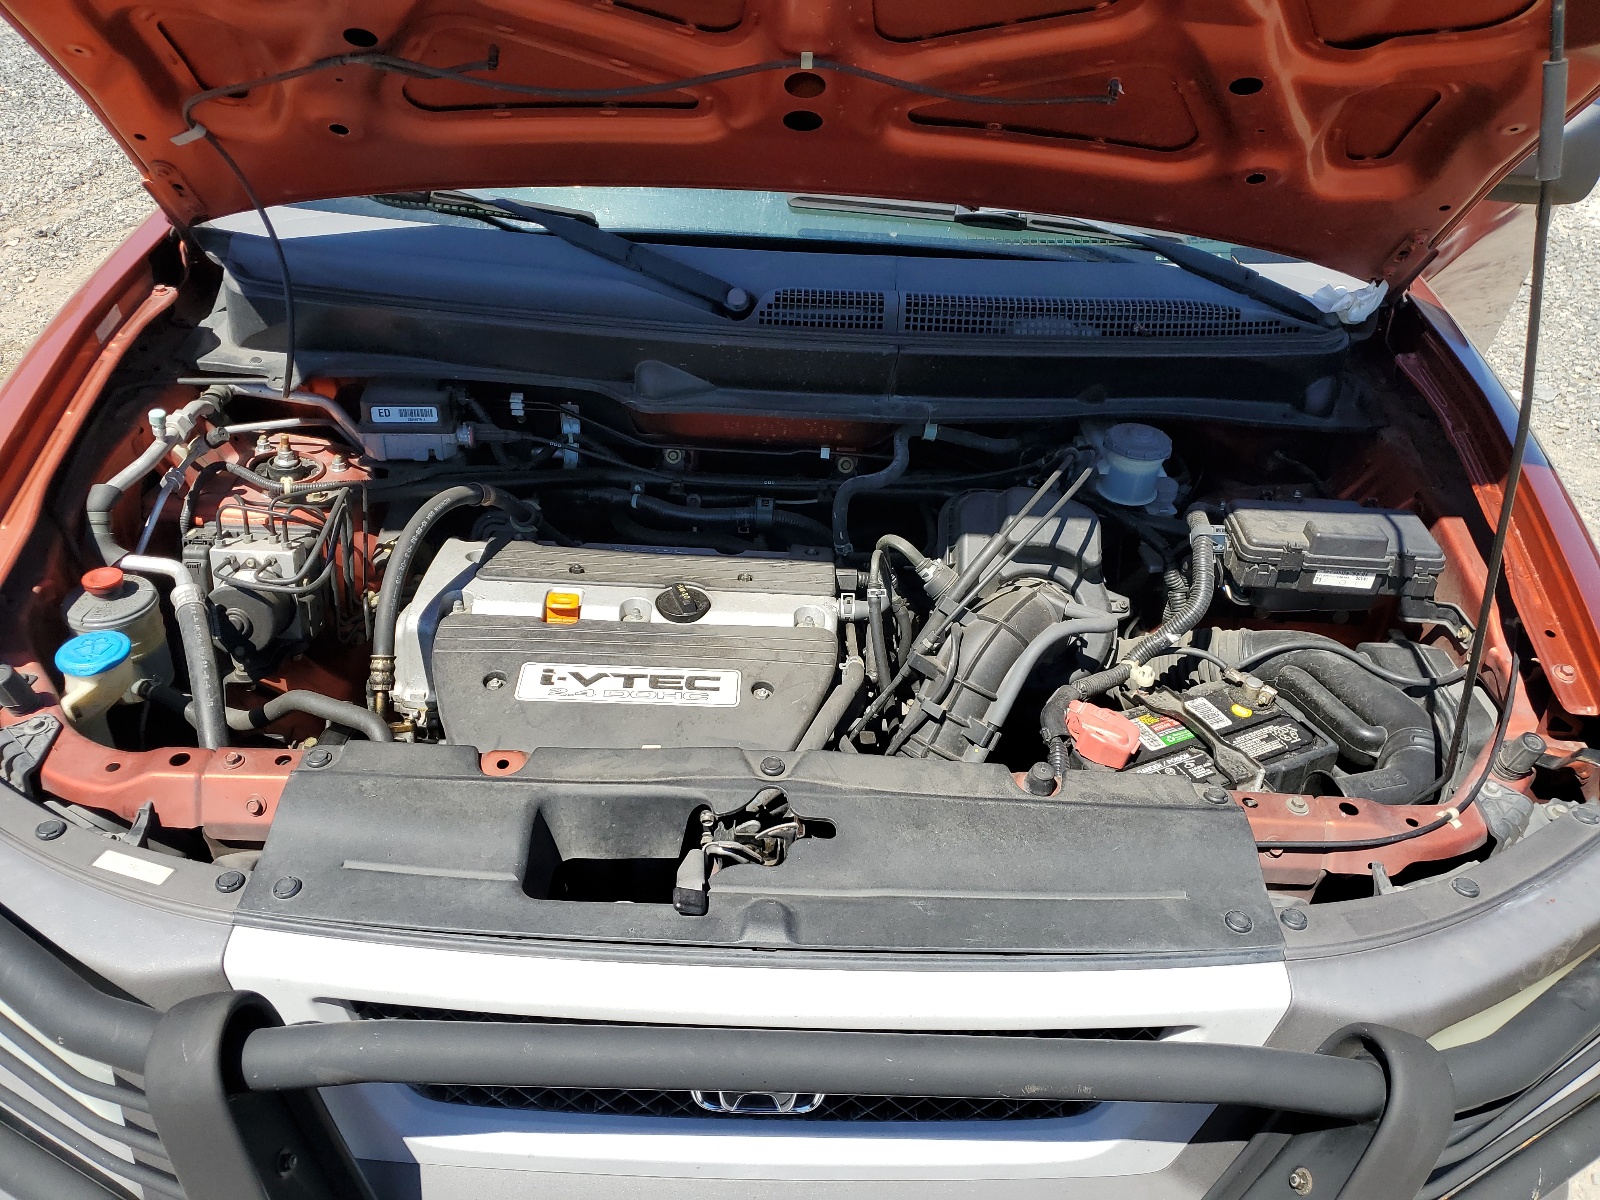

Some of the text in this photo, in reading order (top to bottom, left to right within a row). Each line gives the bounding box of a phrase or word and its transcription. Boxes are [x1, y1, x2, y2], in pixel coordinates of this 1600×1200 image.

[378, 408, 391, 418] ED
[539, 668, 722, 692] i-VTEC
[548, 687, 710, 701] 2.4 DOHC
[1166, 752, 1192, 765] POISON
